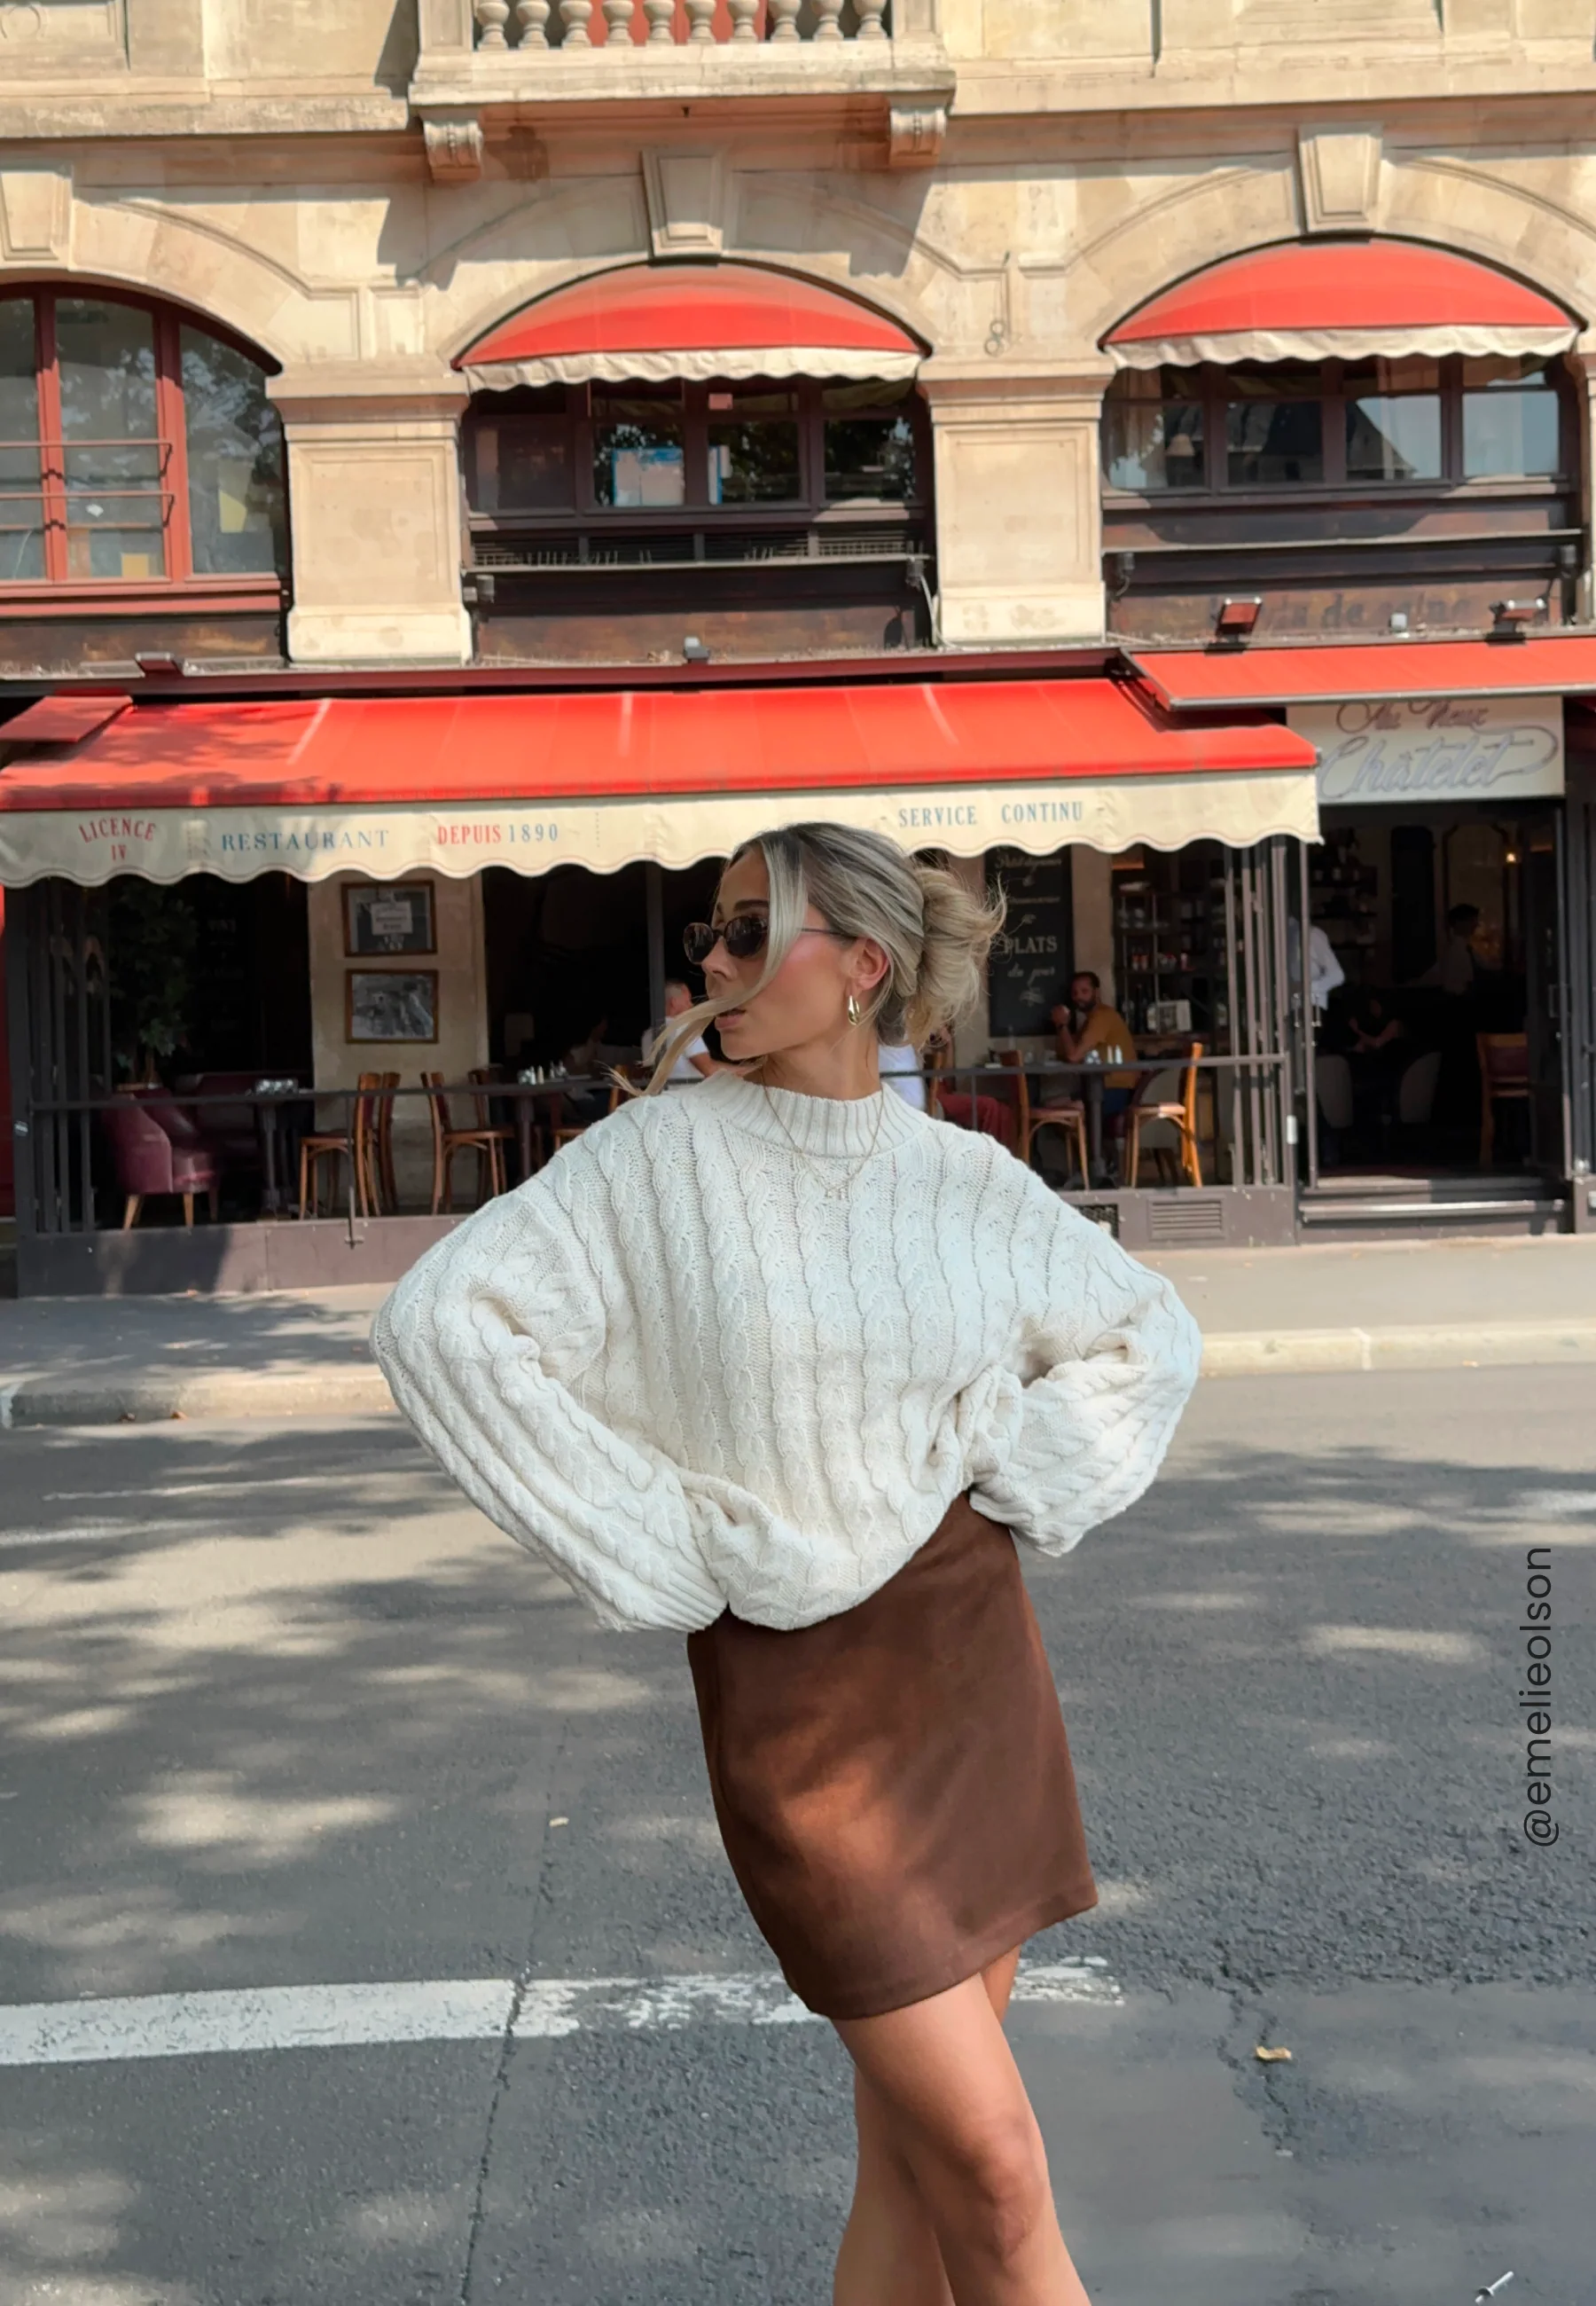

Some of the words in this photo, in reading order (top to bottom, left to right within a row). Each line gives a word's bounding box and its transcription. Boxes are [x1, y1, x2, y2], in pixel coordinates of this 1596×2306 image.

[898, 805, 977, 827] SERVICE
[1001, 802, 1084, 824] CONTINU
[78, 816, 157, 844] LICENCE
[221, 830, 389, 851] RESTAURANT
[437, 825, 502, 845] DEPUIS
[508, 824, 558, 843] 1890
[111, 844, 127, 860] IV
[1003, 936, 1058, 954] PLATS
